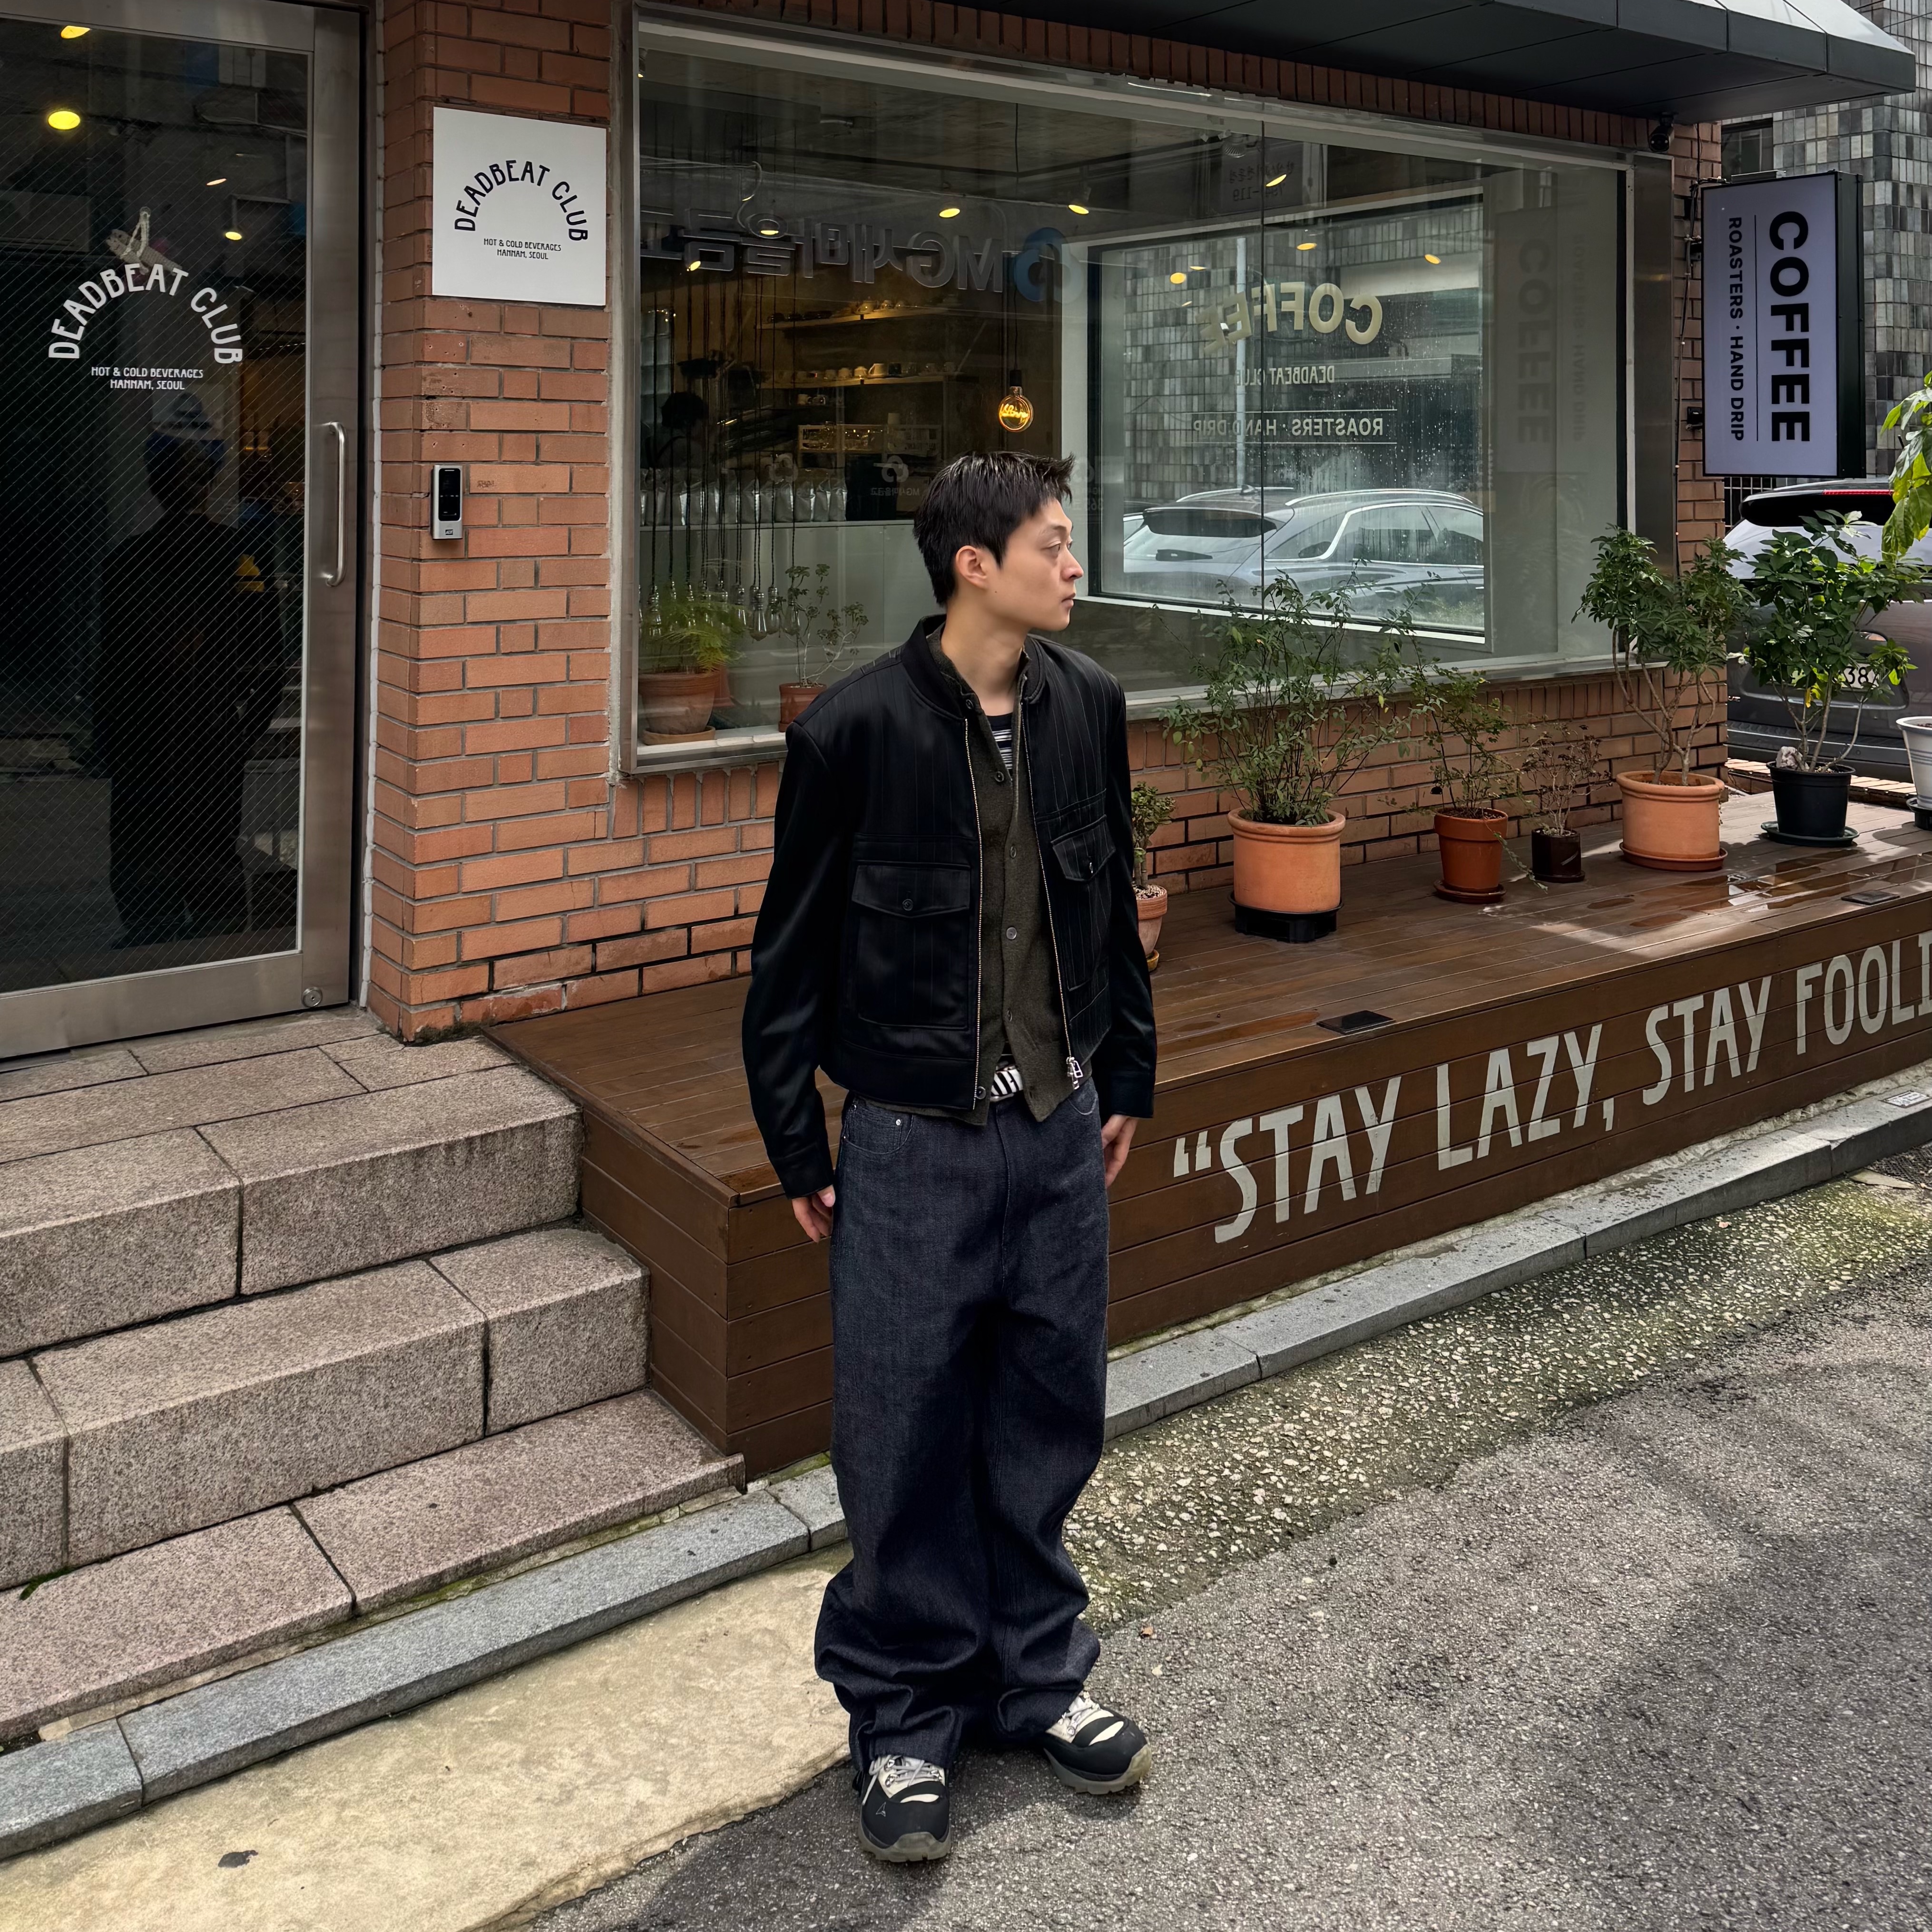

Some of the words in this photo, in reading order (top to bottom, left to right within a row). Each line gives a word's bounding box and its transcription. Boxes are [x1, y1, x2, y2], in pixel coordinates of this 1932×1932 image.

[455, 160, 550, 231] DEADBEAT
[552, 181, 588, 241] CLUB
[506, 240, 523, 248] COLD
[525, 242, 561, 252] BEVERAGES
[529, 251, 549, 260] SEOUL
[1728, 216, 1744, 319] ROASTERS
[49, 263, 189, 359] DEADBEAT
[191, 287, 243, 364] CLUB
[1769, 211, 1810, 442] COFFEE
[91, 367, 110, 377] HOT
[113, 367, 121, 377] &
[123, 367, 148, 377] COLD
[150, 368, 203, 378] BEVERAGES
[156, 381, 185, 390] SEOUL
[1730, 336, 1744, 391] HAND
[1731, 397, 1744, 441] DRIP
[1436, 1024, 1615, 1171] LAZY,
[1643, 976, 1772, 1106] STAY
